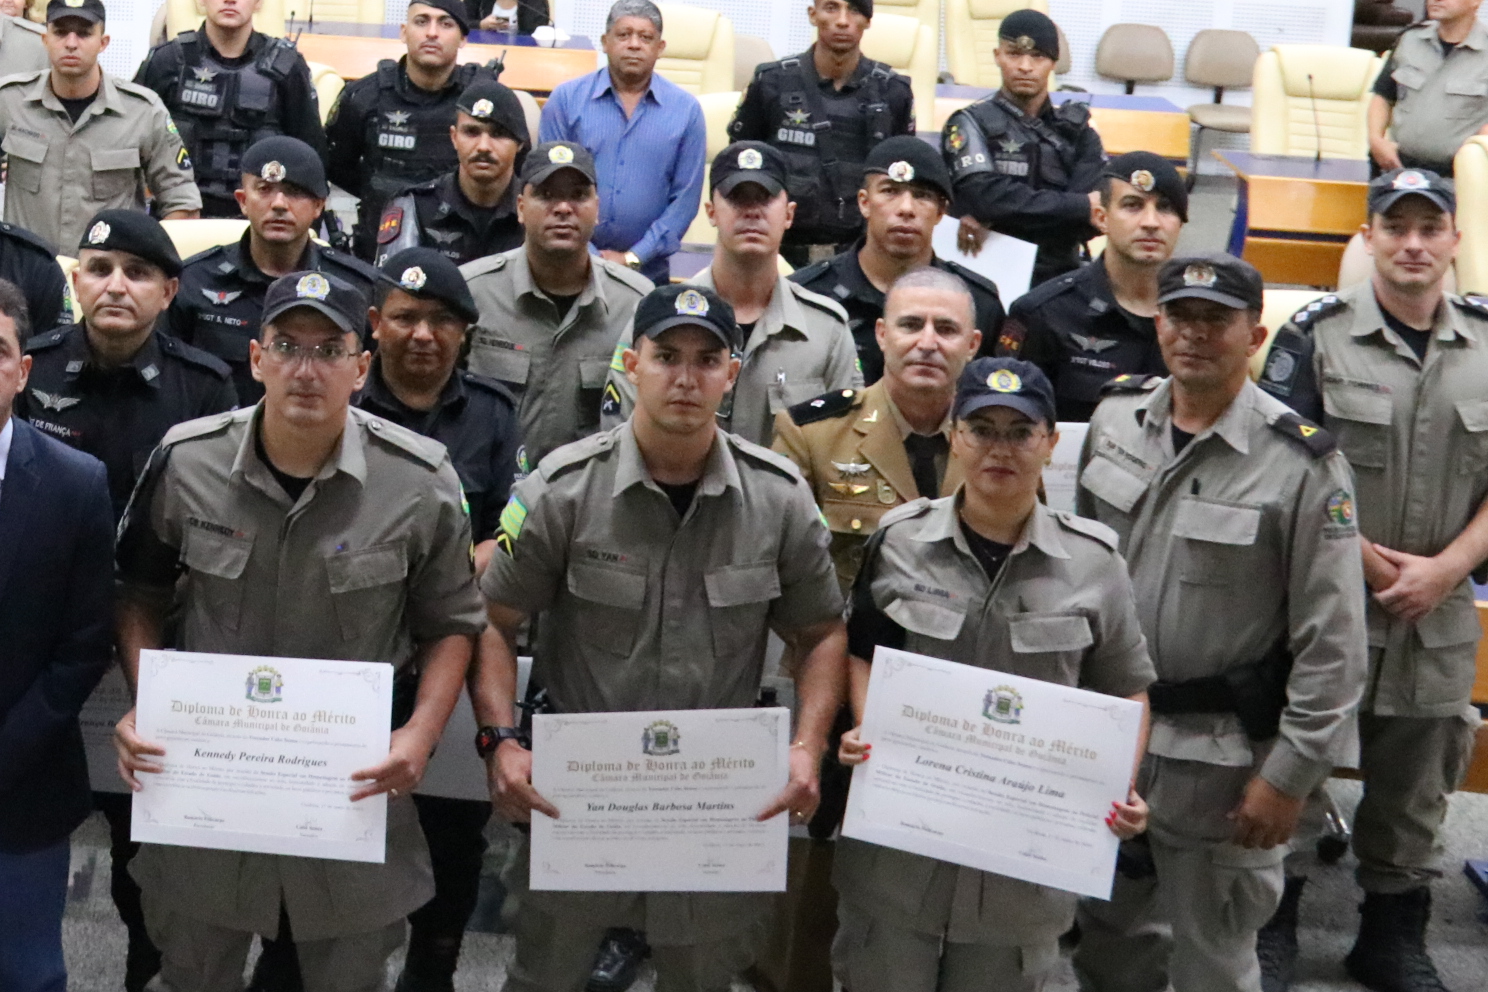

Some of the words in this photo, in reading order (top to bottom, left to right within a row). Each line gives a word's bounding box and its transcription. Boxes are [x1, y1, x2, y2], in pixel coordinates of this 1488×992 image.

[182, 89, 218, 108] GIRO
[378, 133, 416, 148] GIRO
[778, 128, 816, 146] GIRO
[224, 317, 242, 326] NETO
[34, 420, 44, 428] DE
[44, 422, 70, 437] FRANÇA
[170, 700, 224, 716] Diploma
[229, 706, 242, 716] de
[246, 704, 288, 720] Honra
[292, 711, 307, 721] ao
[311, 710, 356, 725] Mérito
[901, 704, 958, 728] Diploma
[962, 718, 978, 732] de
[981, 722, 1026, 744] Honra
[1029, 734, 1045, 748] ao
[1048, 737, 1098, 760] Mérito
[194, 748, 236, 760] Kennedy
[239, 752, 274, 764] Pereira
[278, 754, 328, 768] Rodrigues
[626, 761, 640, 772] de
[690, 761, 705, 770] ao
[915, 754, 953, 773] Lorena
[956, 764, 996, 783] Cristina
[1000, 776, 1036, 794] Araújo
[1038, 783, 1066, 798] Lima
[586, 802, 605, 812] Yan
[608, 802, 649, 813] Douglas
[652, 802, 693, 811] Barbosa
[696, 801, 734, 810] Martins
